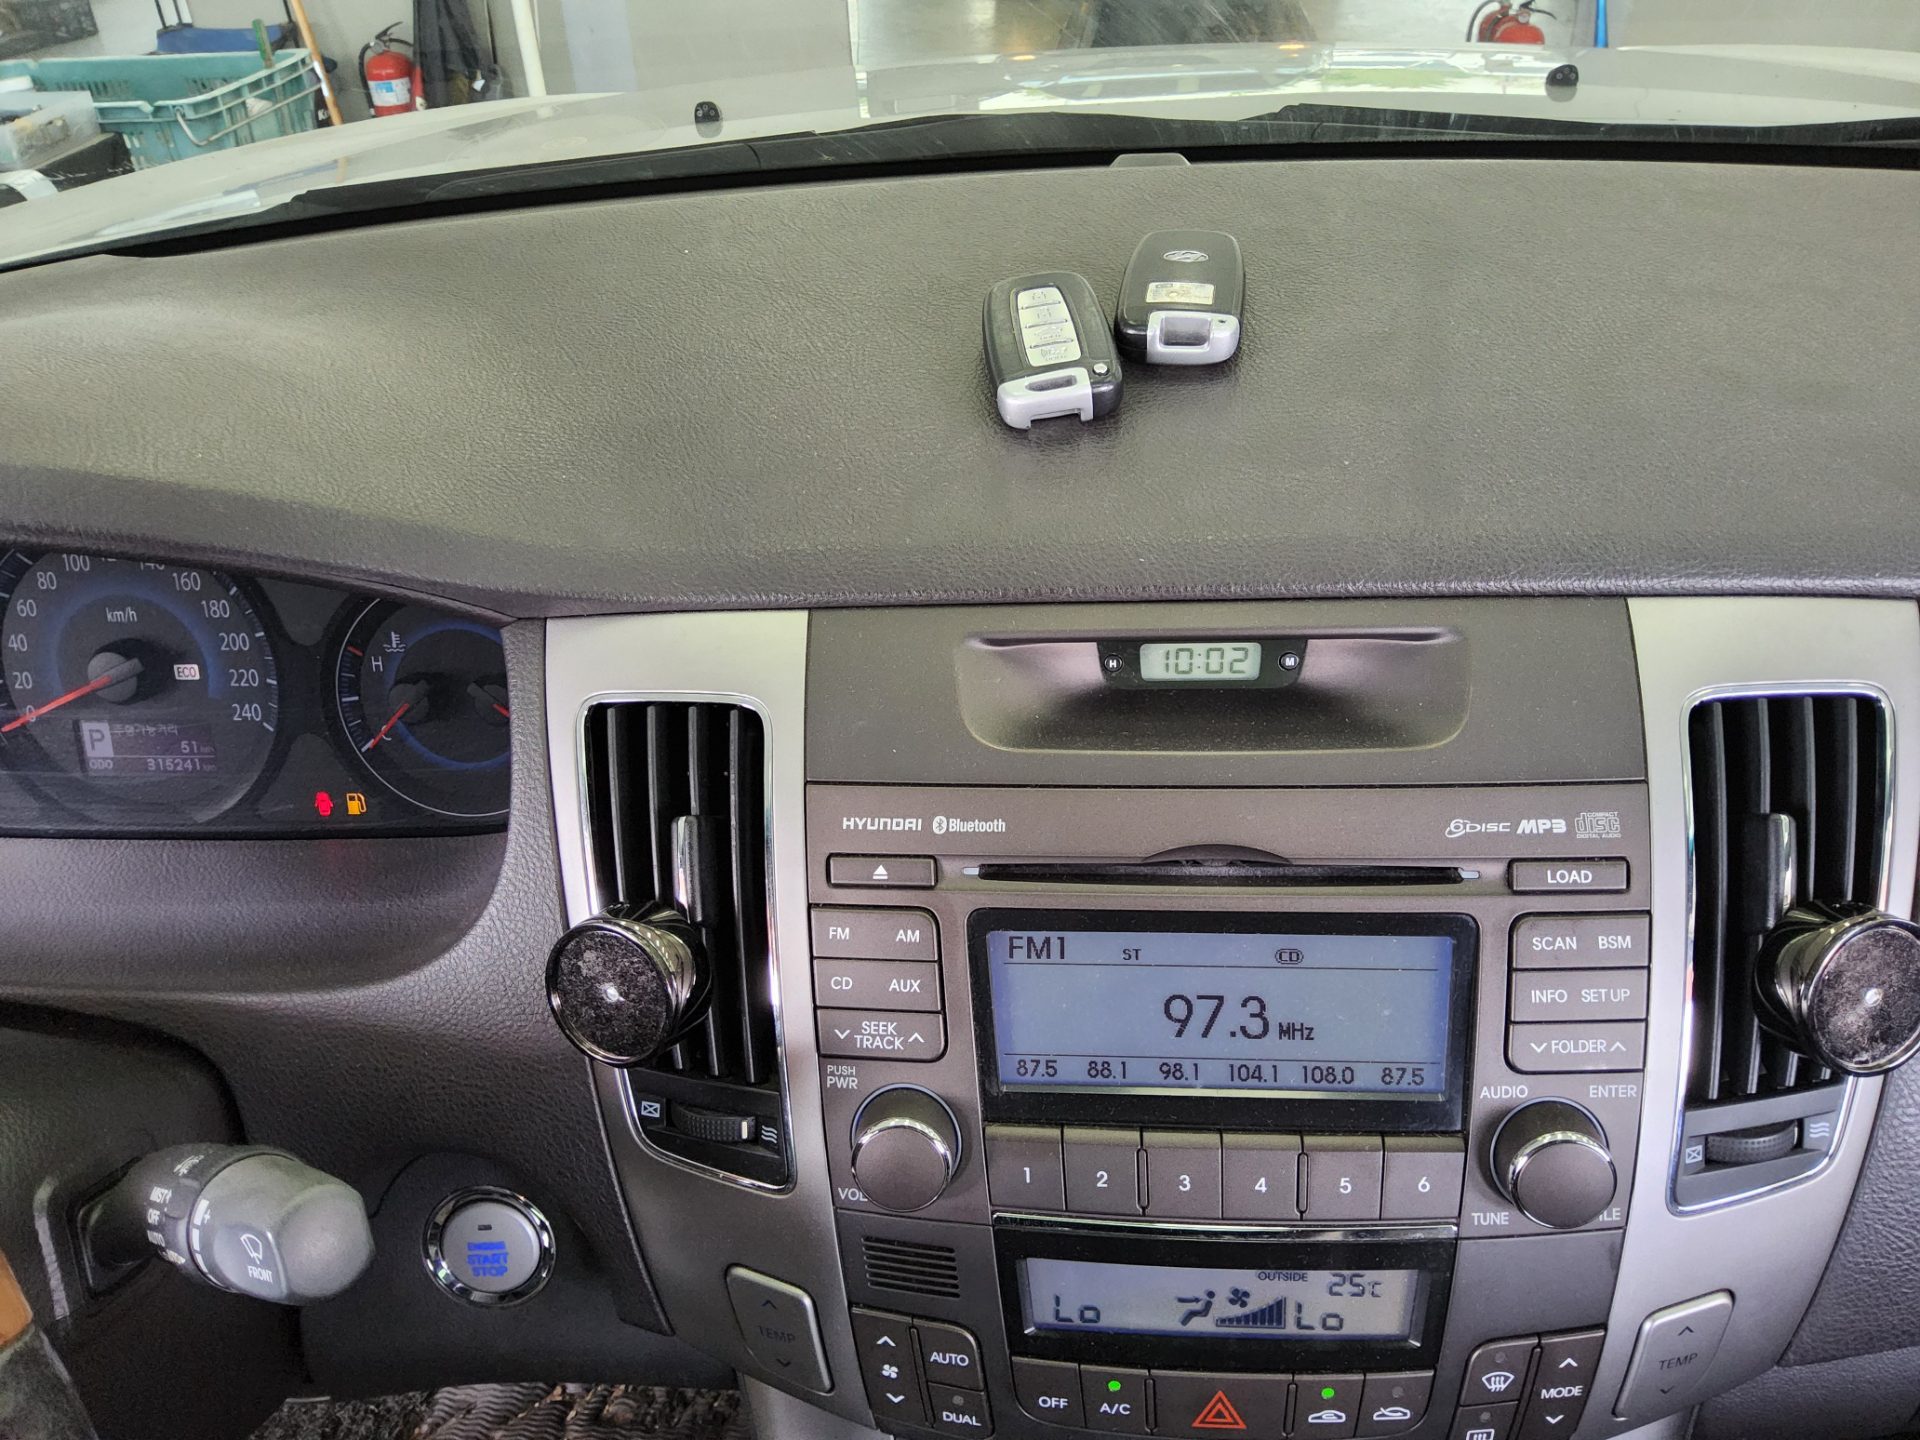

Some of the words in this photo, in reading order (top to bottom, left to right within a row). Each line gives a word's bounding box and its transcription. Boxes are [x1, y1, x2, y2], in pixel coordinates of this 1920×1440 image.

[62, 554, 90, 571] 100
[37, 572, 57, 590] 80
[172, 572, 200, 591] 160
[17, 599, 37, 617] 60
[106, 606, 138, 623] km/h
[201, 600, 230, 618] 180
[8, 634, 28, 651] 40
[219, 633, 249, 651] 200
[371, 656, 383, 672] H
[1109, 659, 1117, 669] H
[1165, 647, 1249, 675] 10:02
[1285, 657, 1295, 667] M
[177, 666, 196, 678] ECO
[229, 669, 259, 687] 220
[14, 672, 33, 689] 20
[232, 704, 262, 721] 240
[89, 729, 105, 751] P
[181, 741, 197, 753] 51
[147, 758, 200, 771] 315241
[842, 817, 922, 831] HYUNDAI
[949, 816, 1006, 834] Bluetooth
[1517, 819, 1567, 834] MP3
[1574, 813, 1621, 834] disc
[1547, 870, 1593, 884] LOAD
[828, 927, 850, 940] FM
[896, 929, 920, 943] AM
[1008, 936, 1065, 960] FM1
[1532, 937, 1577, 951] SCAN
[1598, 936, 1632, 949] BSM
[1122, 948, 1141, 961] ST
[831, 976, 853, 990] CD
[889, 979, 920, 993] AUX
[1531, 990, 1568, 1003] INFO
[1163, 994, 1270, 1040] 97.3
[1278, 1022, 1315, 1041] MHz
[861, 1021, 897, 1035] SEEK
[854, 1035, 904, 1050] TRACK
[1551, 1039, 1607, 1054] FOLDER
[827, 1064, 856, 1076] PUSH
[1016, 1059, 1058, 1078] 87.5
[1087, 1061, 1127, 1080] 88.1
[1159, 1062, 1199, 1081] 98.1
[1228, 1064, 1279, 1083] 104.1
[1302, 1066, 1355, 1085] 108.0
[1380, 1067, 1425, 1086] 87.5
[826, 1076, 858, 1090] PWR
[1480, 1085, 1529, 1099] AUDIO
[1589, 1085, 1637, 1099] ENTER
[1022, 1168, 1031, 1184] 1
[1096, 1171, 1109, 1188] 2
[1178, 1175, 1192, 1192] 3
[1254, 1178, 1267, 1193] 4
[1339, 1177, 1352, 1194] 5
[1418, 1176, 1430, 1193] 6
[147, 1209, 161, 1225] OFF
[1471, 1213, 1509, 1226] TUNE
[1598, 1207, 1621, 1221] ILE
[467, 1253, 508, 1265] START
[247, 1265, 273, 1283] FRONT
[472, 1266, 508, 1277] STOP
[1257, 1271, 1309, 1282] OUTSIDE
[757, 1325, 796, 1344] TEMP
[929, 1350, 970, 1367] AUTO
[1657, 1353, 1699, 1370] TEMP
[1540, 1385, 1583, 1400] MODE
[1038, 1396, 1069, 1410] OFF
[1099, 1402, 1131, 1416] A/C
[942, 1411, 982, 1427] DUAL
